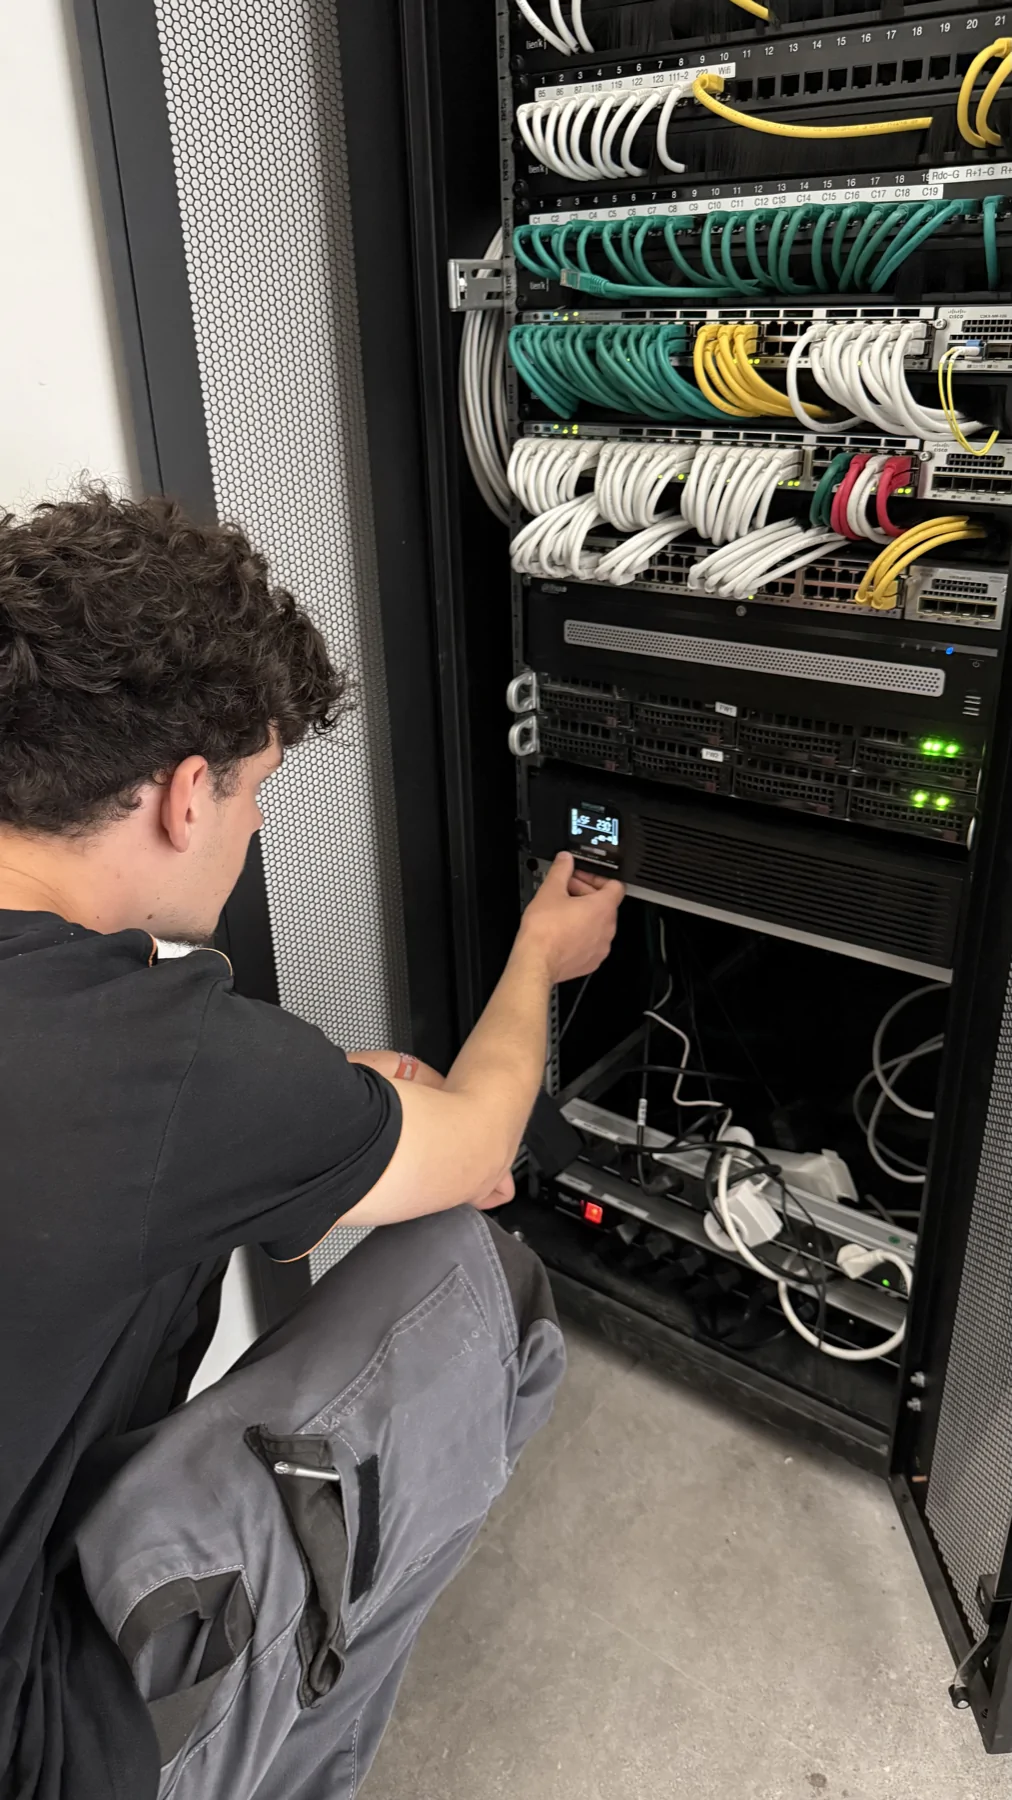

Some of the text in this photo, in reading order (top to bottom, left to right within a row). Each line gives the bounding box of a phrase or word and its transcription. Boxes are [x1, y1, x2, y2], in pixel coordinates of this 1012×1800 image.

[541, 76, 545, 84] 1
[558, 74, 564, 82] 2
[577, 71, 583, 79] 3
[617, 66, 622, 74] 5
[636, 63, 642, 72] 6
[658, 61, 663, 69] 7
[678, 58, 684, 66] 8
[700, 55, 705, 63] 9
[720, 52, 729, 61] 10
[742, 49, 751, 58] 11
[764, 46, 774, 56] 12
[789, 43, 798, 53] 13
[812, 40, 822, 49] 14
[836, 36, 847, 46] 15
[861, 33, 871, 43] 16
[886, 30, 896, 40] 17
[912, 26, 923, 36] 18
[940, 22, 951, 33] 19
[966, 19, 978, 30] 20
[995, 16, 1006, 26] 21
[611, 80, 622, 89] 119
[632, 78, 643, 86] 122
[652, 74, 664, 83] 123
[669, 72, 688, 81] 111-2
[718, 66, 731, 75] Wifi
[932, 170, 960, 180] Rdc-G
[966, 167, 995, 178] R+1-G
[540, 200, 544, 208] 1
[556, 199, 562, 207] 2
[593, 196, 598, 204] 4
[612, 194, 617, 202] 5
[631, 193, 636, 202] 6
[652, 192, 657, 200] 7
[671, 190, 677, 199] 8
[692, 189, 697, 198] 9
[711, 188, 720, 196] 10
[733, 186, 741, 195] 11
[754, 184, 763, 193] 12
[777, 183, 786, 192] 13
[799, 181, 809, 190] 14
[823, 180, 832, 189] 15
[846, 178, 856, 188] 16
[870, 176, 880, 185] 17
[895, 174, 905, 184] 18
[628, 207, 636, 216] C6
[648, 205, 657, 214] C7
[668, 204, 677, 213] C8
[689, 203, 698, 212] C9
[708, 201, 722, 210] C10
[731, 199, 744, 208] C11
[754, 197, 768, 206] C12
[772, 196, 786, 204] C13
[796, 194, 811, 203] C14
[822, 192, 837, 201] C15
[844, 190, 860, 200] C16
[871, 189, 886, 199] C17
[895, 188, 910, 197] C18
[922, 187, 938, 196] C19
